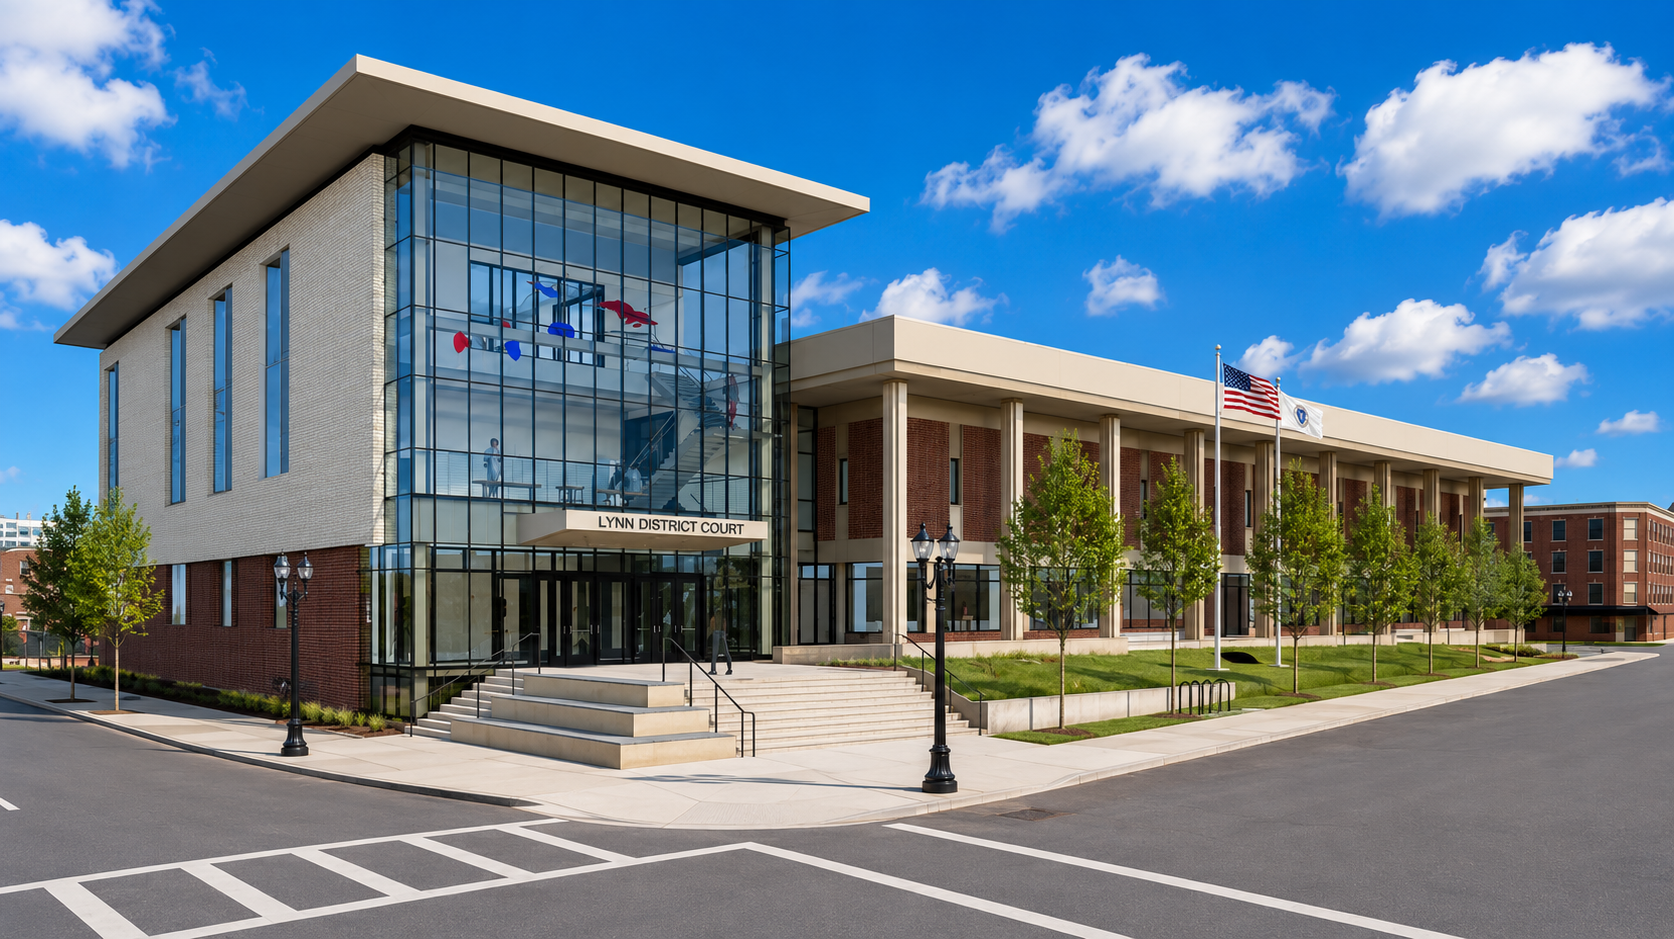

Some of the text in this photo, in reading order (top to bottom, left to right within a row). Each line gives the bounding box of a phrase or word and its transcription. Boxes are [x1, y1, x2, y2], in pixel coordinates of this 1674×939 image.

[598, 516, 745, 535] LYNN DISTRICT COURT
